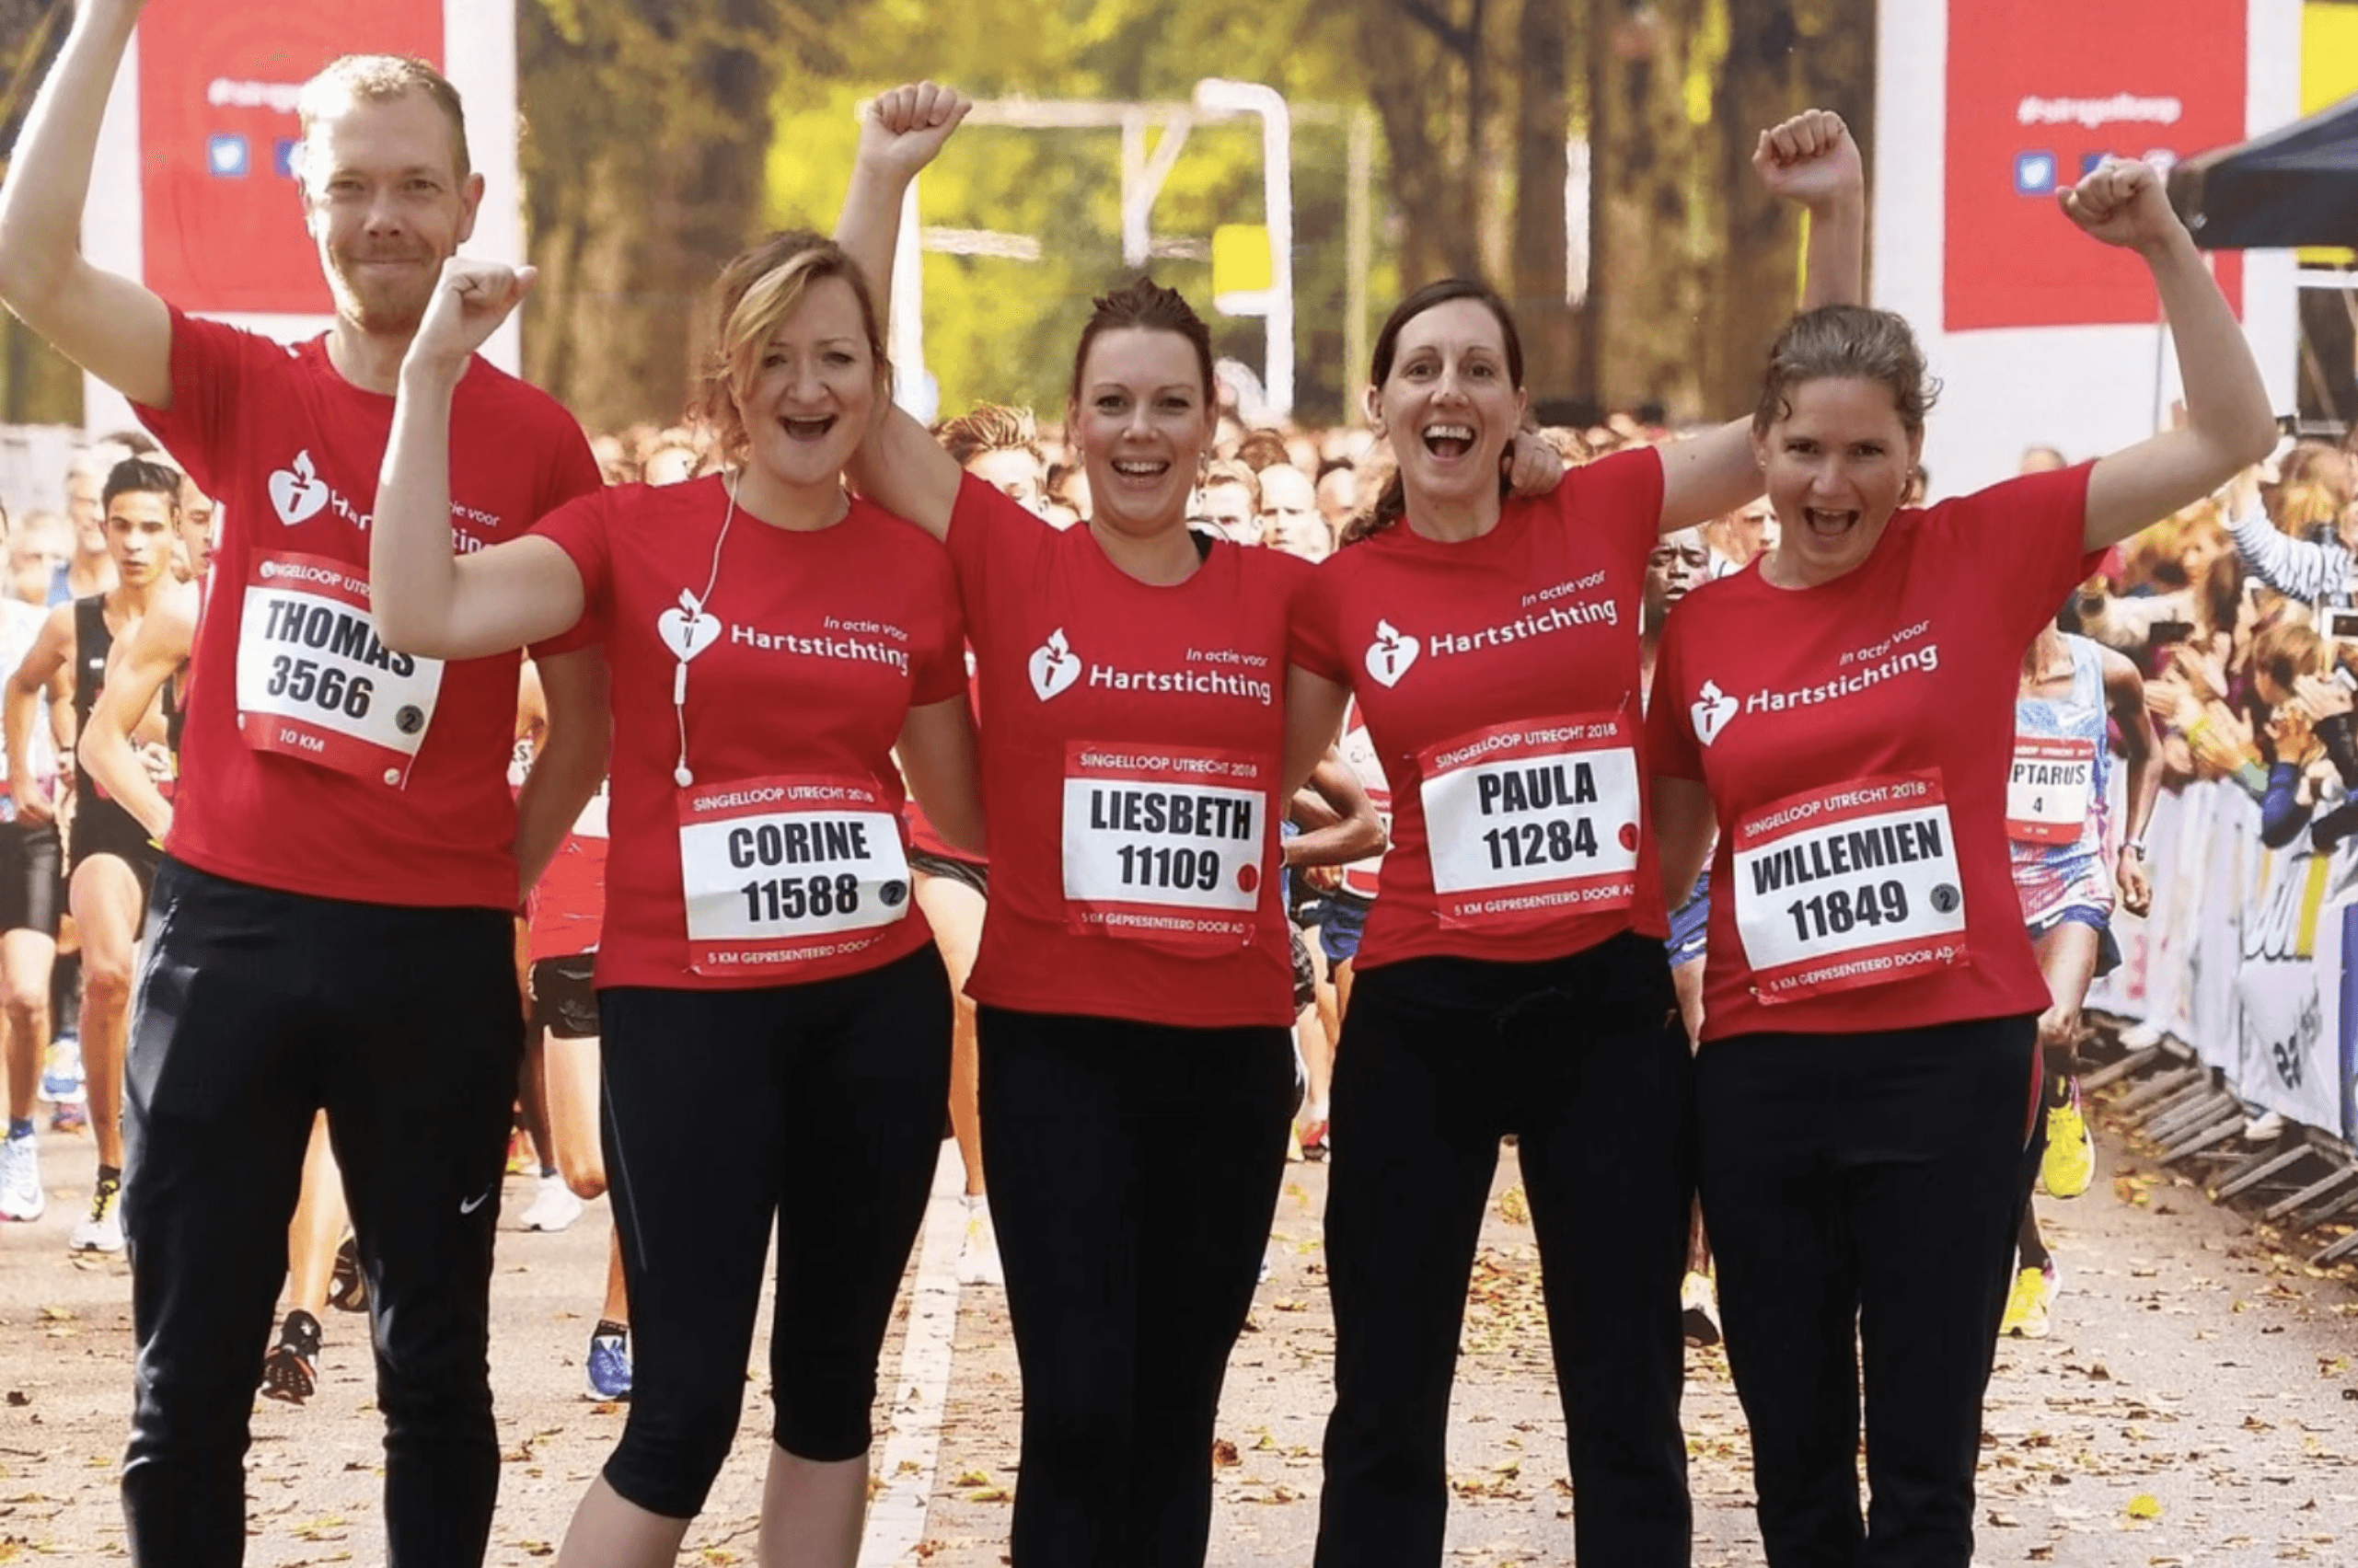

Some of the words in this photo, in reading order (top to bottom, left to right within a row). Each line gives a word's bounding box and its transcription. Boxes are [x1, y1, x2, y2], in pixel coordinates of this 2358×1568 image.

[468, 508, 501, 526] voor
[267, 563, 341, 584] NGELLOOP
[1522, 594, 1537, 607] In
[1540, 582, 1575, 601] actie
[1577, 570, 1605, 590] voor
[265, 599, 415, 678] THOMAS
[824, 616, 839, 629] In
[842, 619, 881, 633] actie
[1430, 598, 1618, 658] Hartstichting
[1839, 651, 1855, 666] In
[1891, 619, 1930, 643] voor
[731, 623, 909, 677] Hartstichting
[1186, 648, 1203, 661] In
[1205, 649, 1240, 664] actie
[1242, 654, 1268, 667] voor
[267, 654, 375, 720] 3566
[1089, 663, 1272, 706] Hartstichting
[1745, 643, 1937, 714] Hartstichting
[280, 729, 297, 744] 10
[299, 733, 325, 753] KM
[1435, 733, 1521, 768] SINGELLOOP
[1524, 725, 1585, 745] UTRECHT
[1588, 722, 1617, 738] 2018
[1080, 754, 1170, 771] SINGELLOOP
[1173, 757, 1229, 775] UTRECHT
[693, 788, 784, 812] SINGELLOOP
[1477, 762, 1598, 815] PAULA
[1745, 801, 1821, 837] SINGELLOOP
[1824, 787, 1888, 812] UTRECHT
[1891, 782, 1926, 799] 2018
[2032, 796, 2042, 813] 4
[1091, 790, 1252, 840] LIESBETH
[728, 821, 873, 870] CORINE
[1483, 817, 1599, 870] 11284
[1751, 818, 1944, 896] WILLEMIEN
[1116, 844, 1220, 892] 11109
[741, 872, 859, 922] 11588
[1454, 905, 1462, 917] 5
[1463, 903, 1482, 915] KM
[1485, 891, 1580, 912] GEPRESENTEERD
[1582, 885, 1620, 901] DOOR
[1786, 880, 1909, 941] 11849
[1105, 913, 1196, 931] GEPRESENTEERD
[1197, 921, 1230, 934] DOOR
[708, 952, 716, 963] 5
[719, 952, 737, 963] KM
[741, 945, 835, 964] GEPRESENTEERD
[1770, 981, 1779, 991] 5
[1798, 957, 1892, 986] GEPRESENTEERD
[1894, 951, 1932, 967] DOOR
